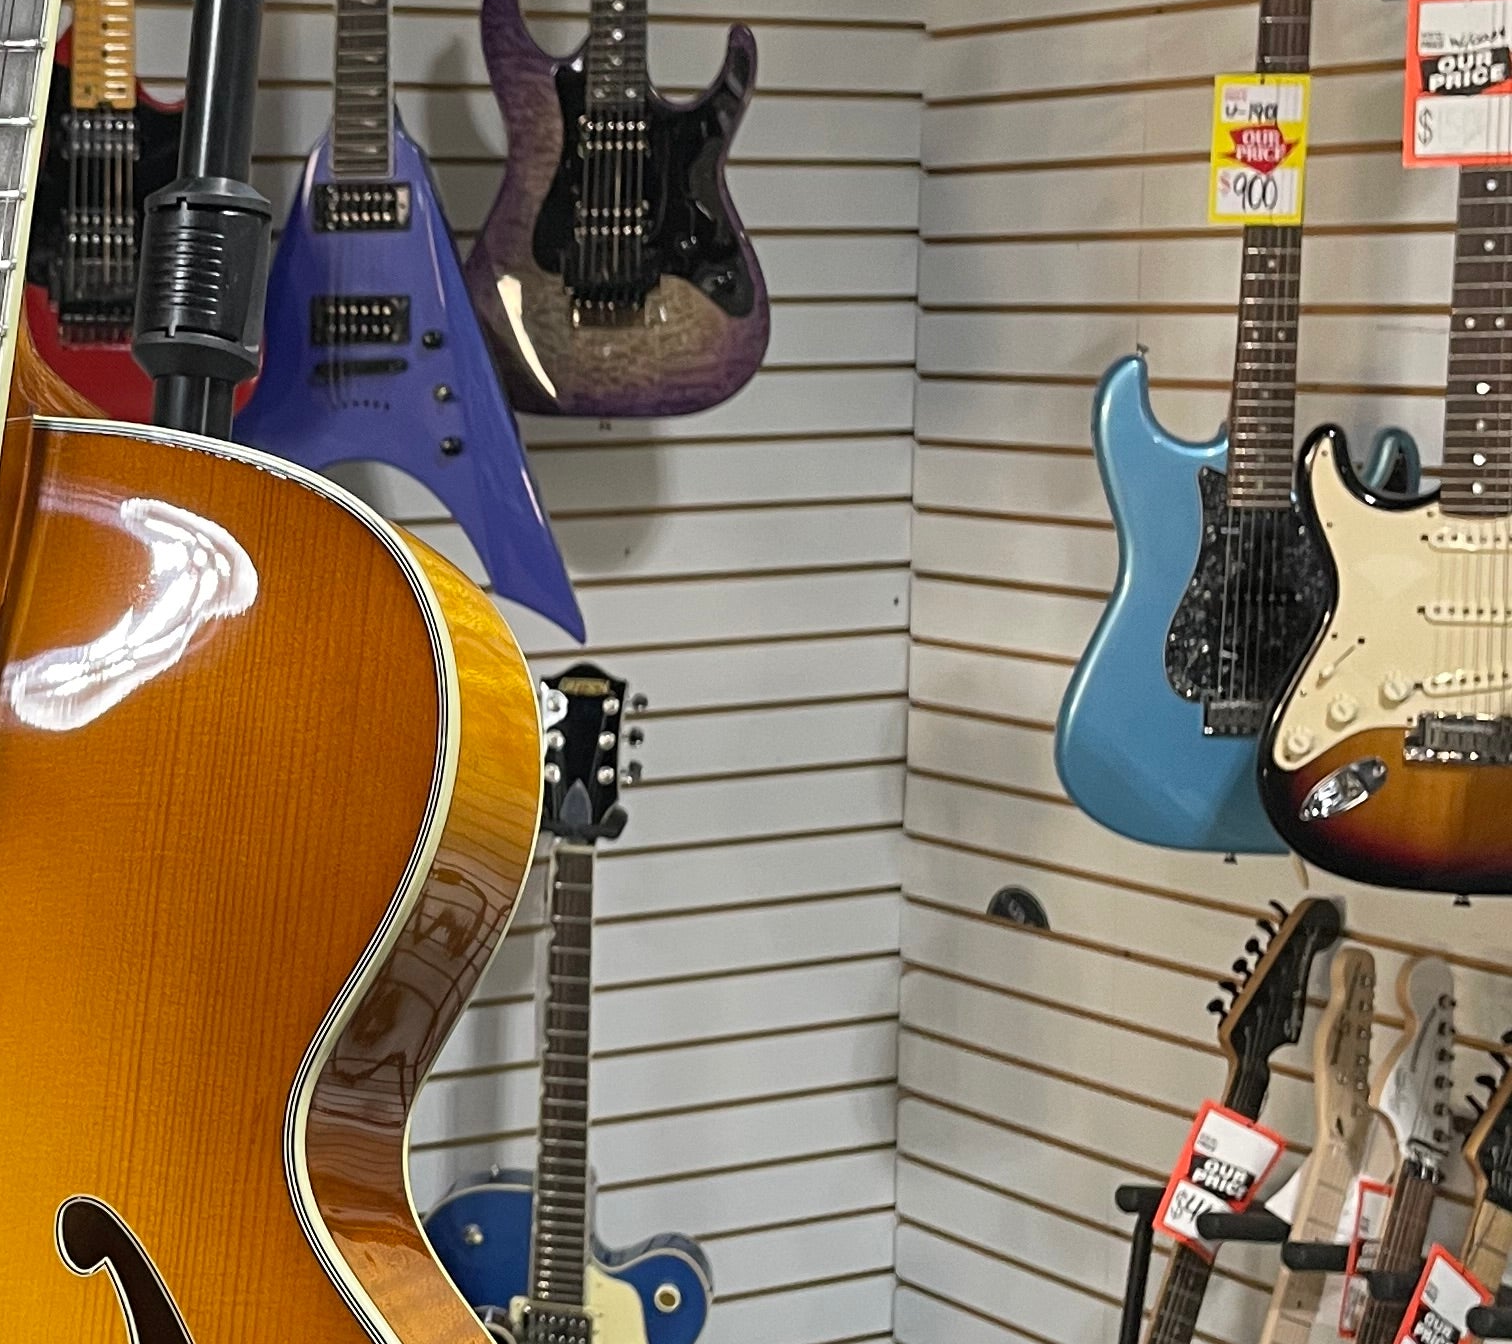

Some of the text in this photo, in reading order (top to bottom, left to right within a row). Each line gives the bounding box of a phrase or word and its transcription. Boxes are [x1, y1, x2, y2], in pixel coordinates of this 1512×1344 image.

[1437, 49, 1492, 75] OUR
[1429, 62, 1506, 93] PRICE
[1241, 127, 1281, 147] OUR
[1235, 142, 1287, 162] PRICE
[1192, 1167, 1248, 1200] PRICE
[1203, 1158, 1248, 1184] OUR
[1424, 1311, 1453, 1338] OUR
